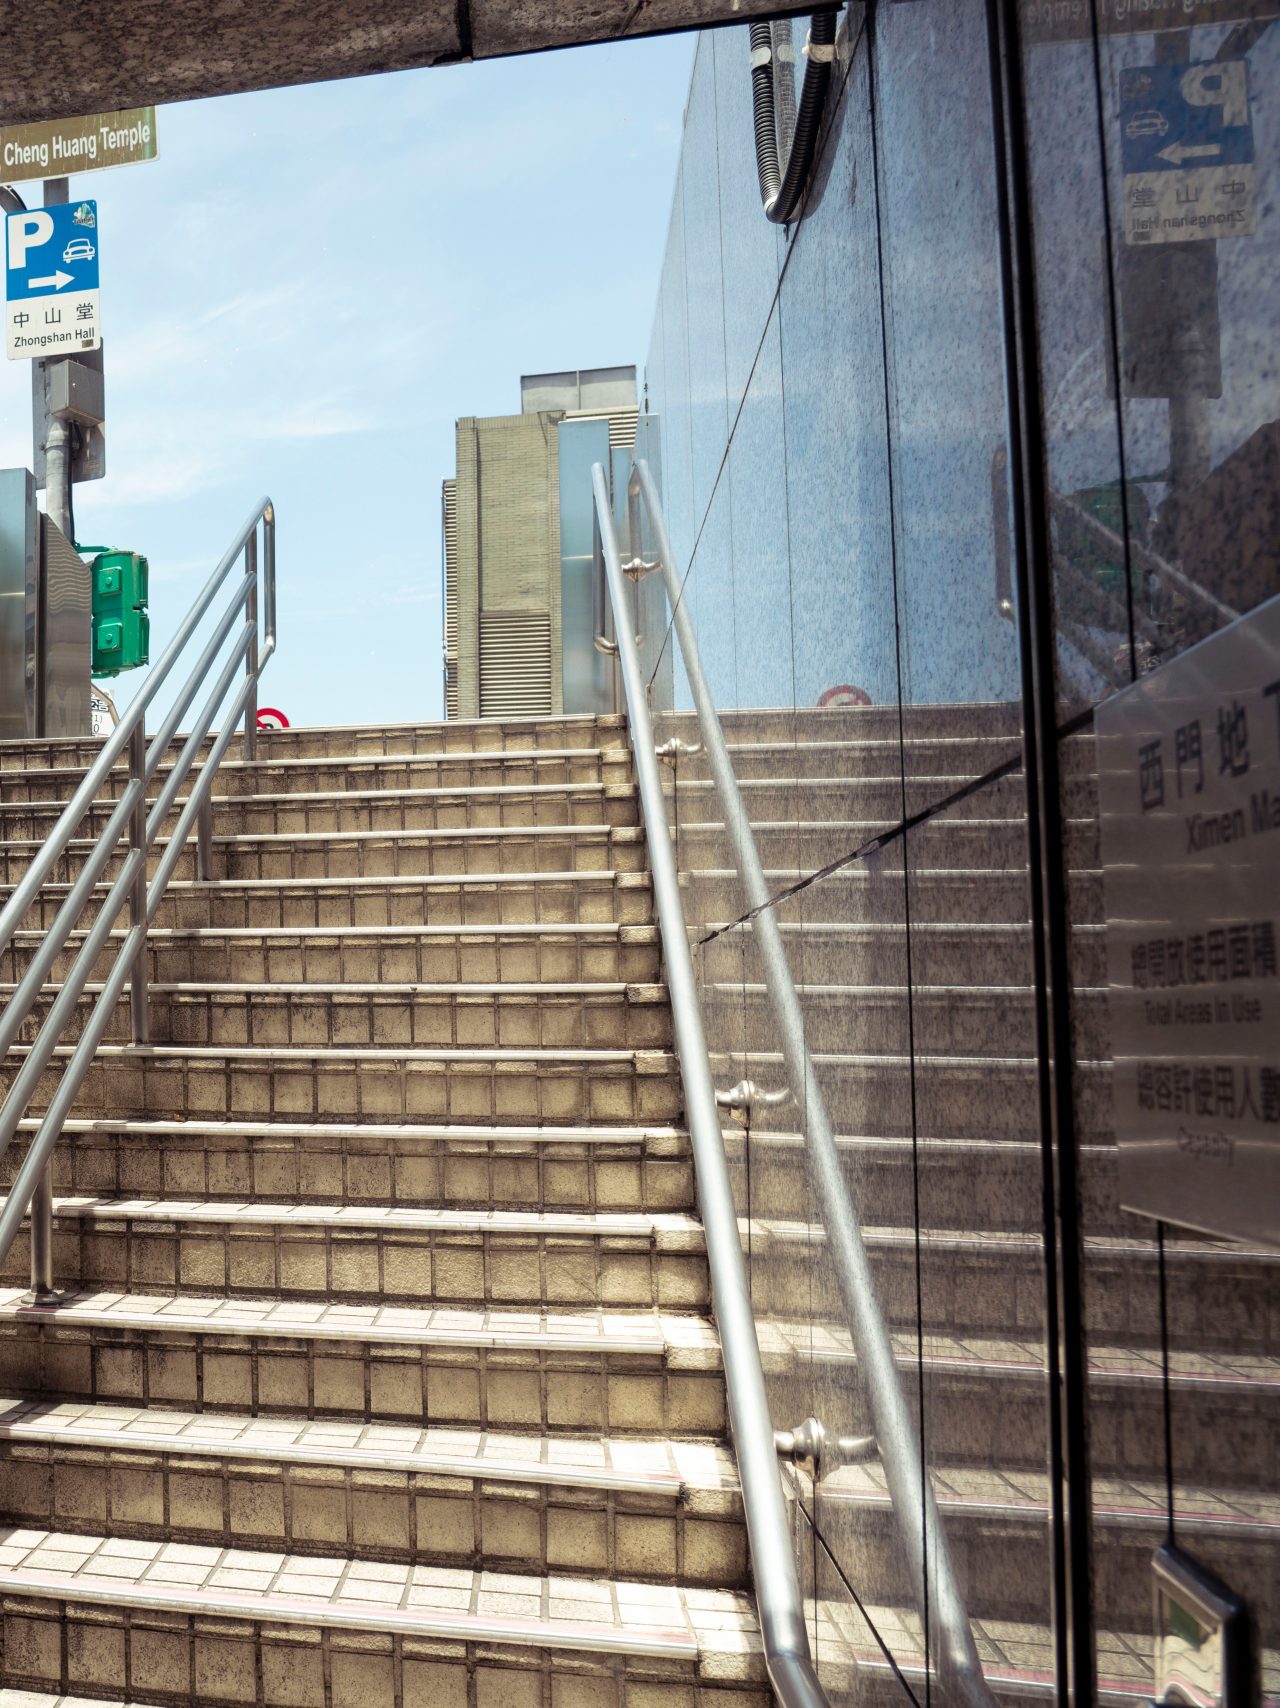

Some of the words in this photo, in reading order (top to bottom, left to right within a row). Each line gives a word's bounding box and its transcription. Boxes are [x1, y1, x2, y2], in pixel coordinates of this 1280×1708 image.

[4, 142, 48, 167] Cheng
[52, 134, 96, 159] Huang
[100, 120, 150, 150] Temple
[8, 210, 54, 270] P
[13, 302, 94, 328] 中山堂
[14, 331, 72, 348] Zhongshan
[75, 327, 95, 340] Hall
